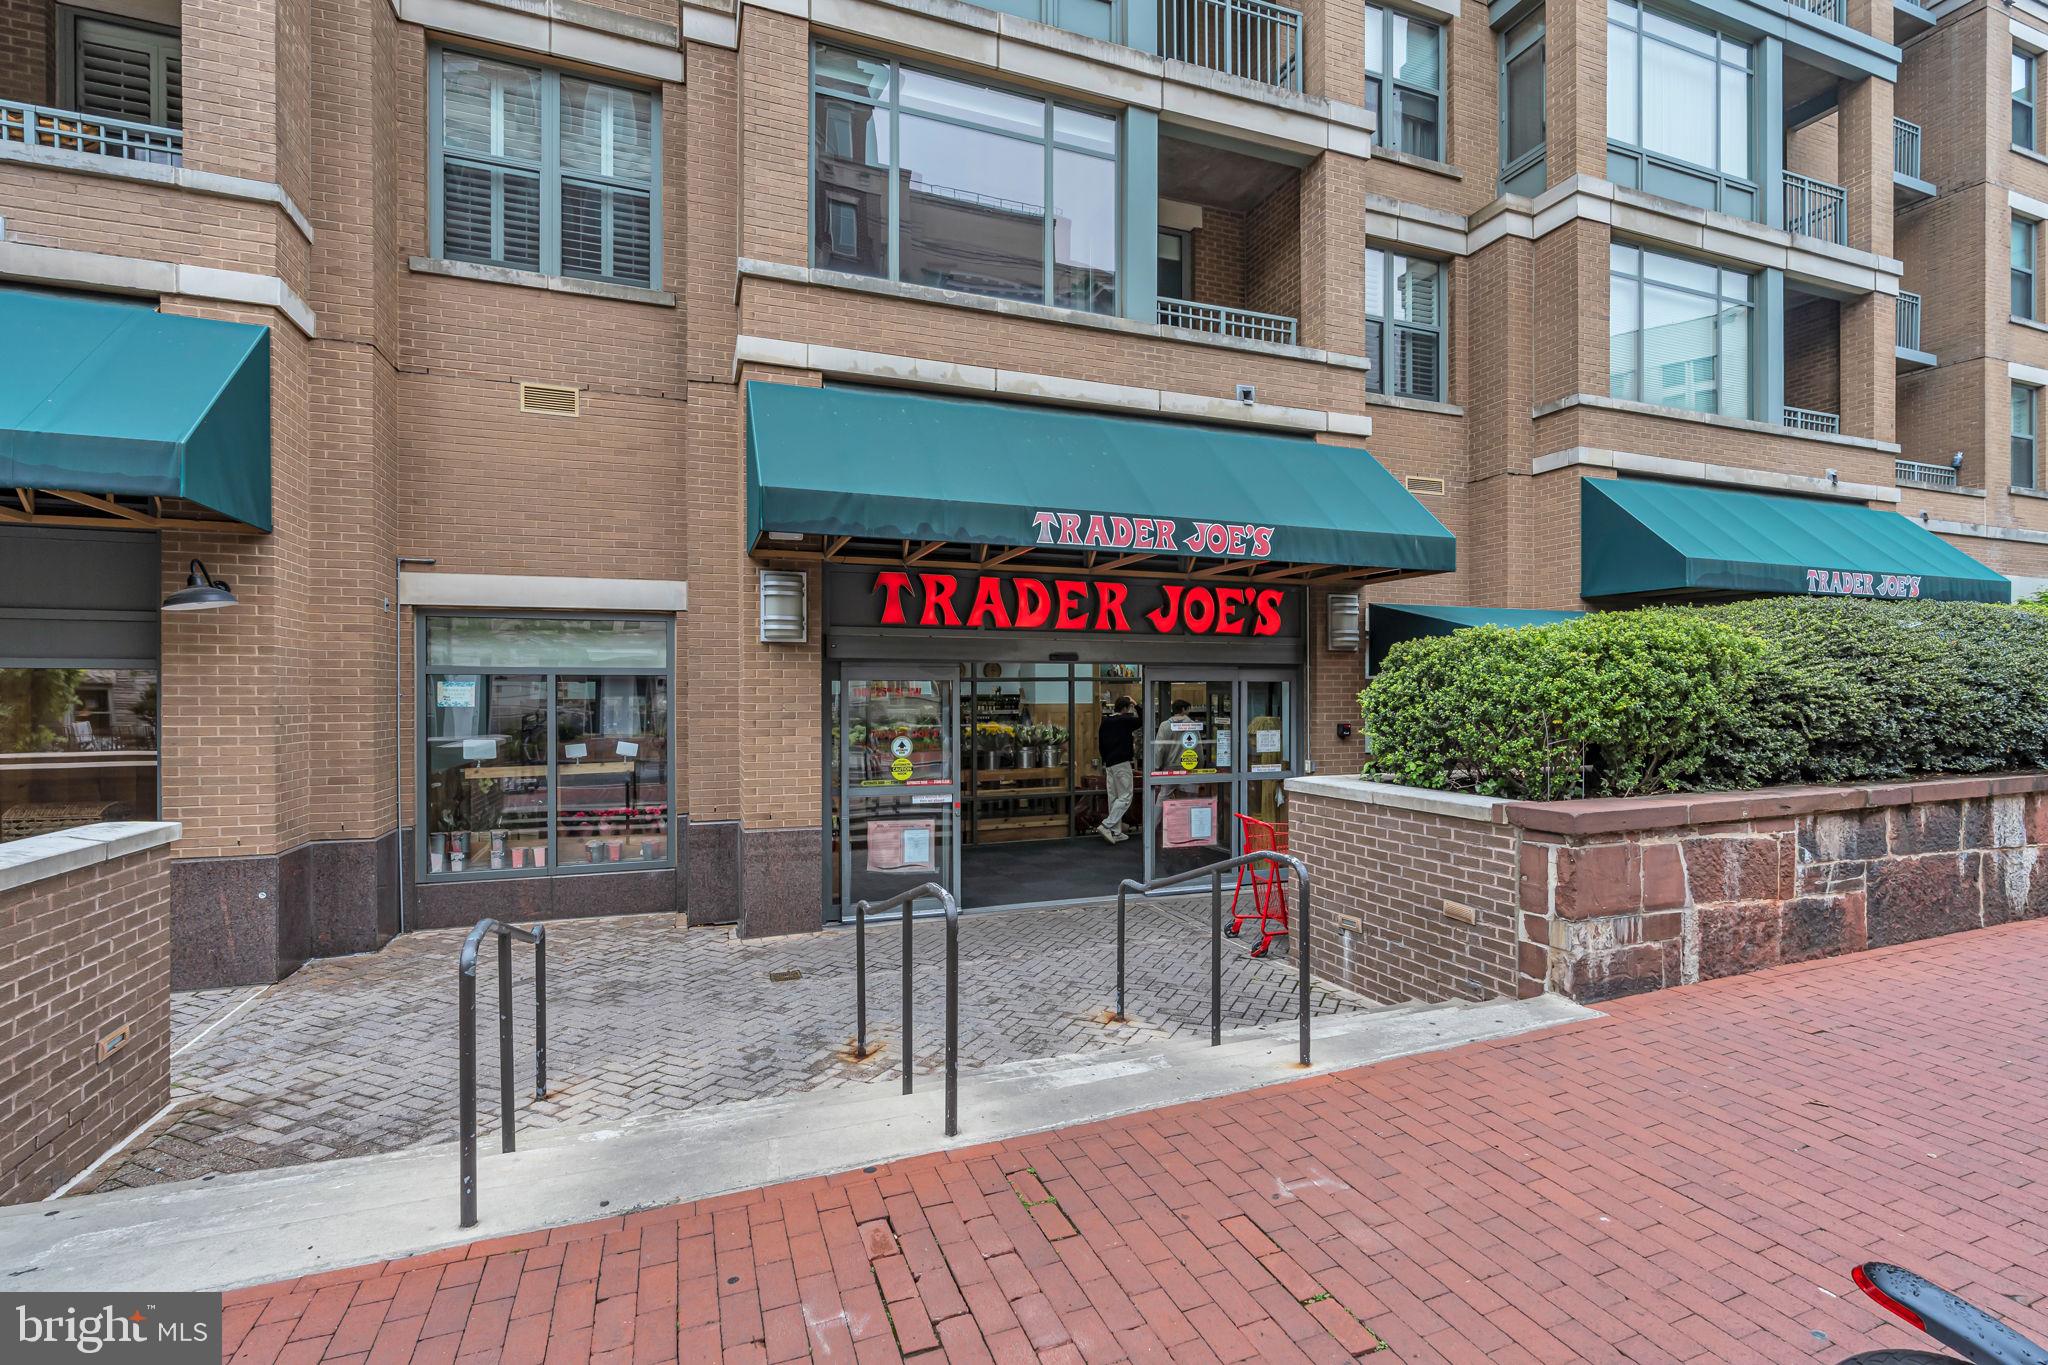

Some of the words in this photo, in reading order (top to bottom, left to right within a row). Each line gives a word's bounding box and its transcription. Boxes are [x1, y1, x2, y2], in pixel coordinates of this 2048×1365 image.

[1032, 511, 1178, 551] TRADER
[1182, 520, 1276, 557] JOE'S
[873, 571, 1131, 631] TRADER
[1145, 585, 1285, 637] JOE'S
[1806, 569, 1874, 595] TRADER
[1876, 574, 1922, 598] JOE'S
